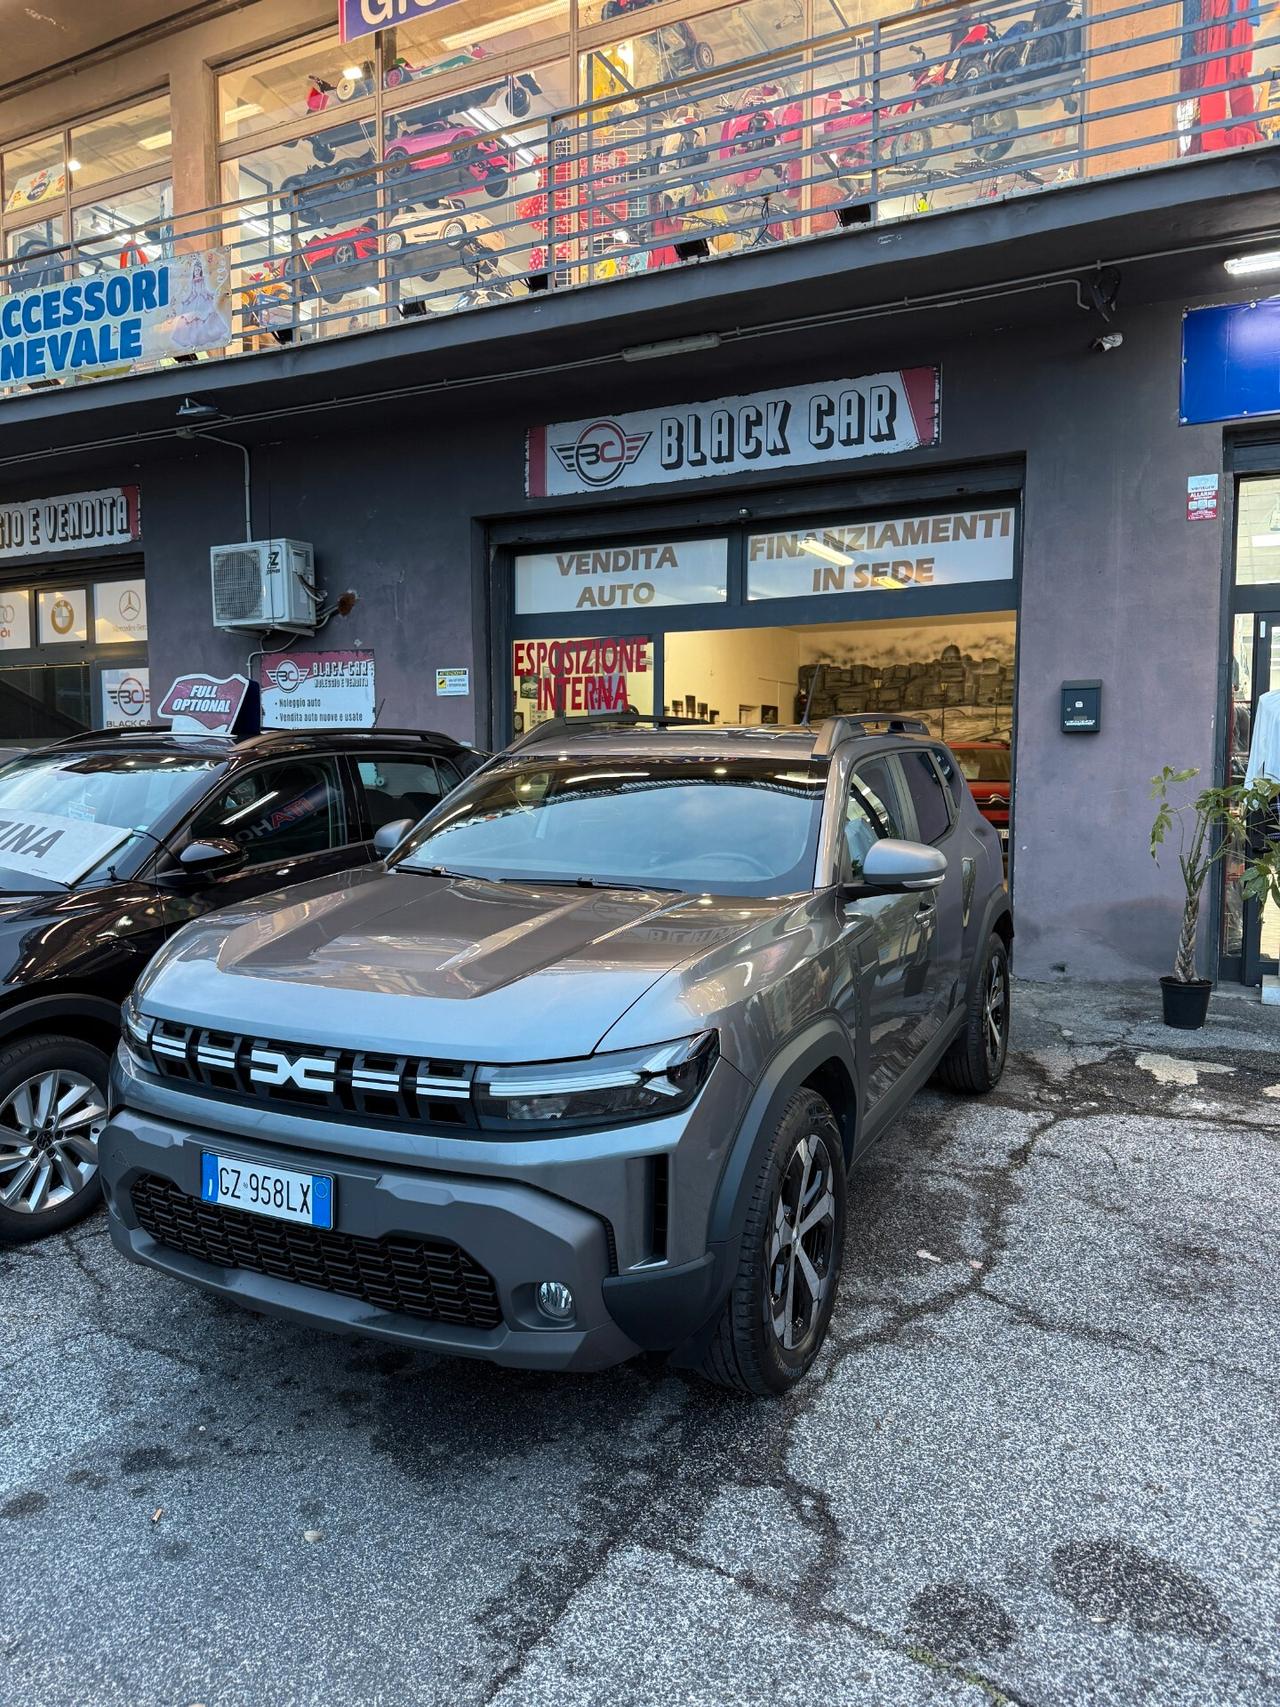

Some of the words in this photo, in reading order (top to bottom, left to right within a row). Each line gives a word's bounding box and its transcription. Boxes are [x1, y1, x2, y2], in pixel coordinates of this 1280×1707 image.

[0, 266, 170, 341] CCESSORI
[660, 400, 792, 470] BLACK
[808, 385, 897, 449] CAR
[28, 507, 41, 545] E
[45, 495, 129, 542] VENDITA
[750, 512, 1011, 561] FINANZIAMENTI
[556, 546, 678, 576] VENDITA
[812, 566, 845, 592] IN
[853, 558, 935, 589] SEDE
[576, 582, 655, 608] AUTO
[312, 662, 345, 677] BLACK
[347, 661, 369, 677] CAR
[514, 637, 647, 676] ESPOSIZIONE
[172, 698, 231, 712] OPTIONAL
[190, 685, 218, 698] FULL
[280, 698, 305, 708] Noleggio
[307, 698, 321, 707] auto
[537, 676, 629, 711] INTERNA
[106, 720, 136, 728] BLACK
[280, 712, 302, 722] Vendita
[304, 713, 318, 722] auto
[345, 712, 363, 721] usate
[219, 1167, 241, 1199] GZ
[249, 1173, 311, 1215] 958LX
